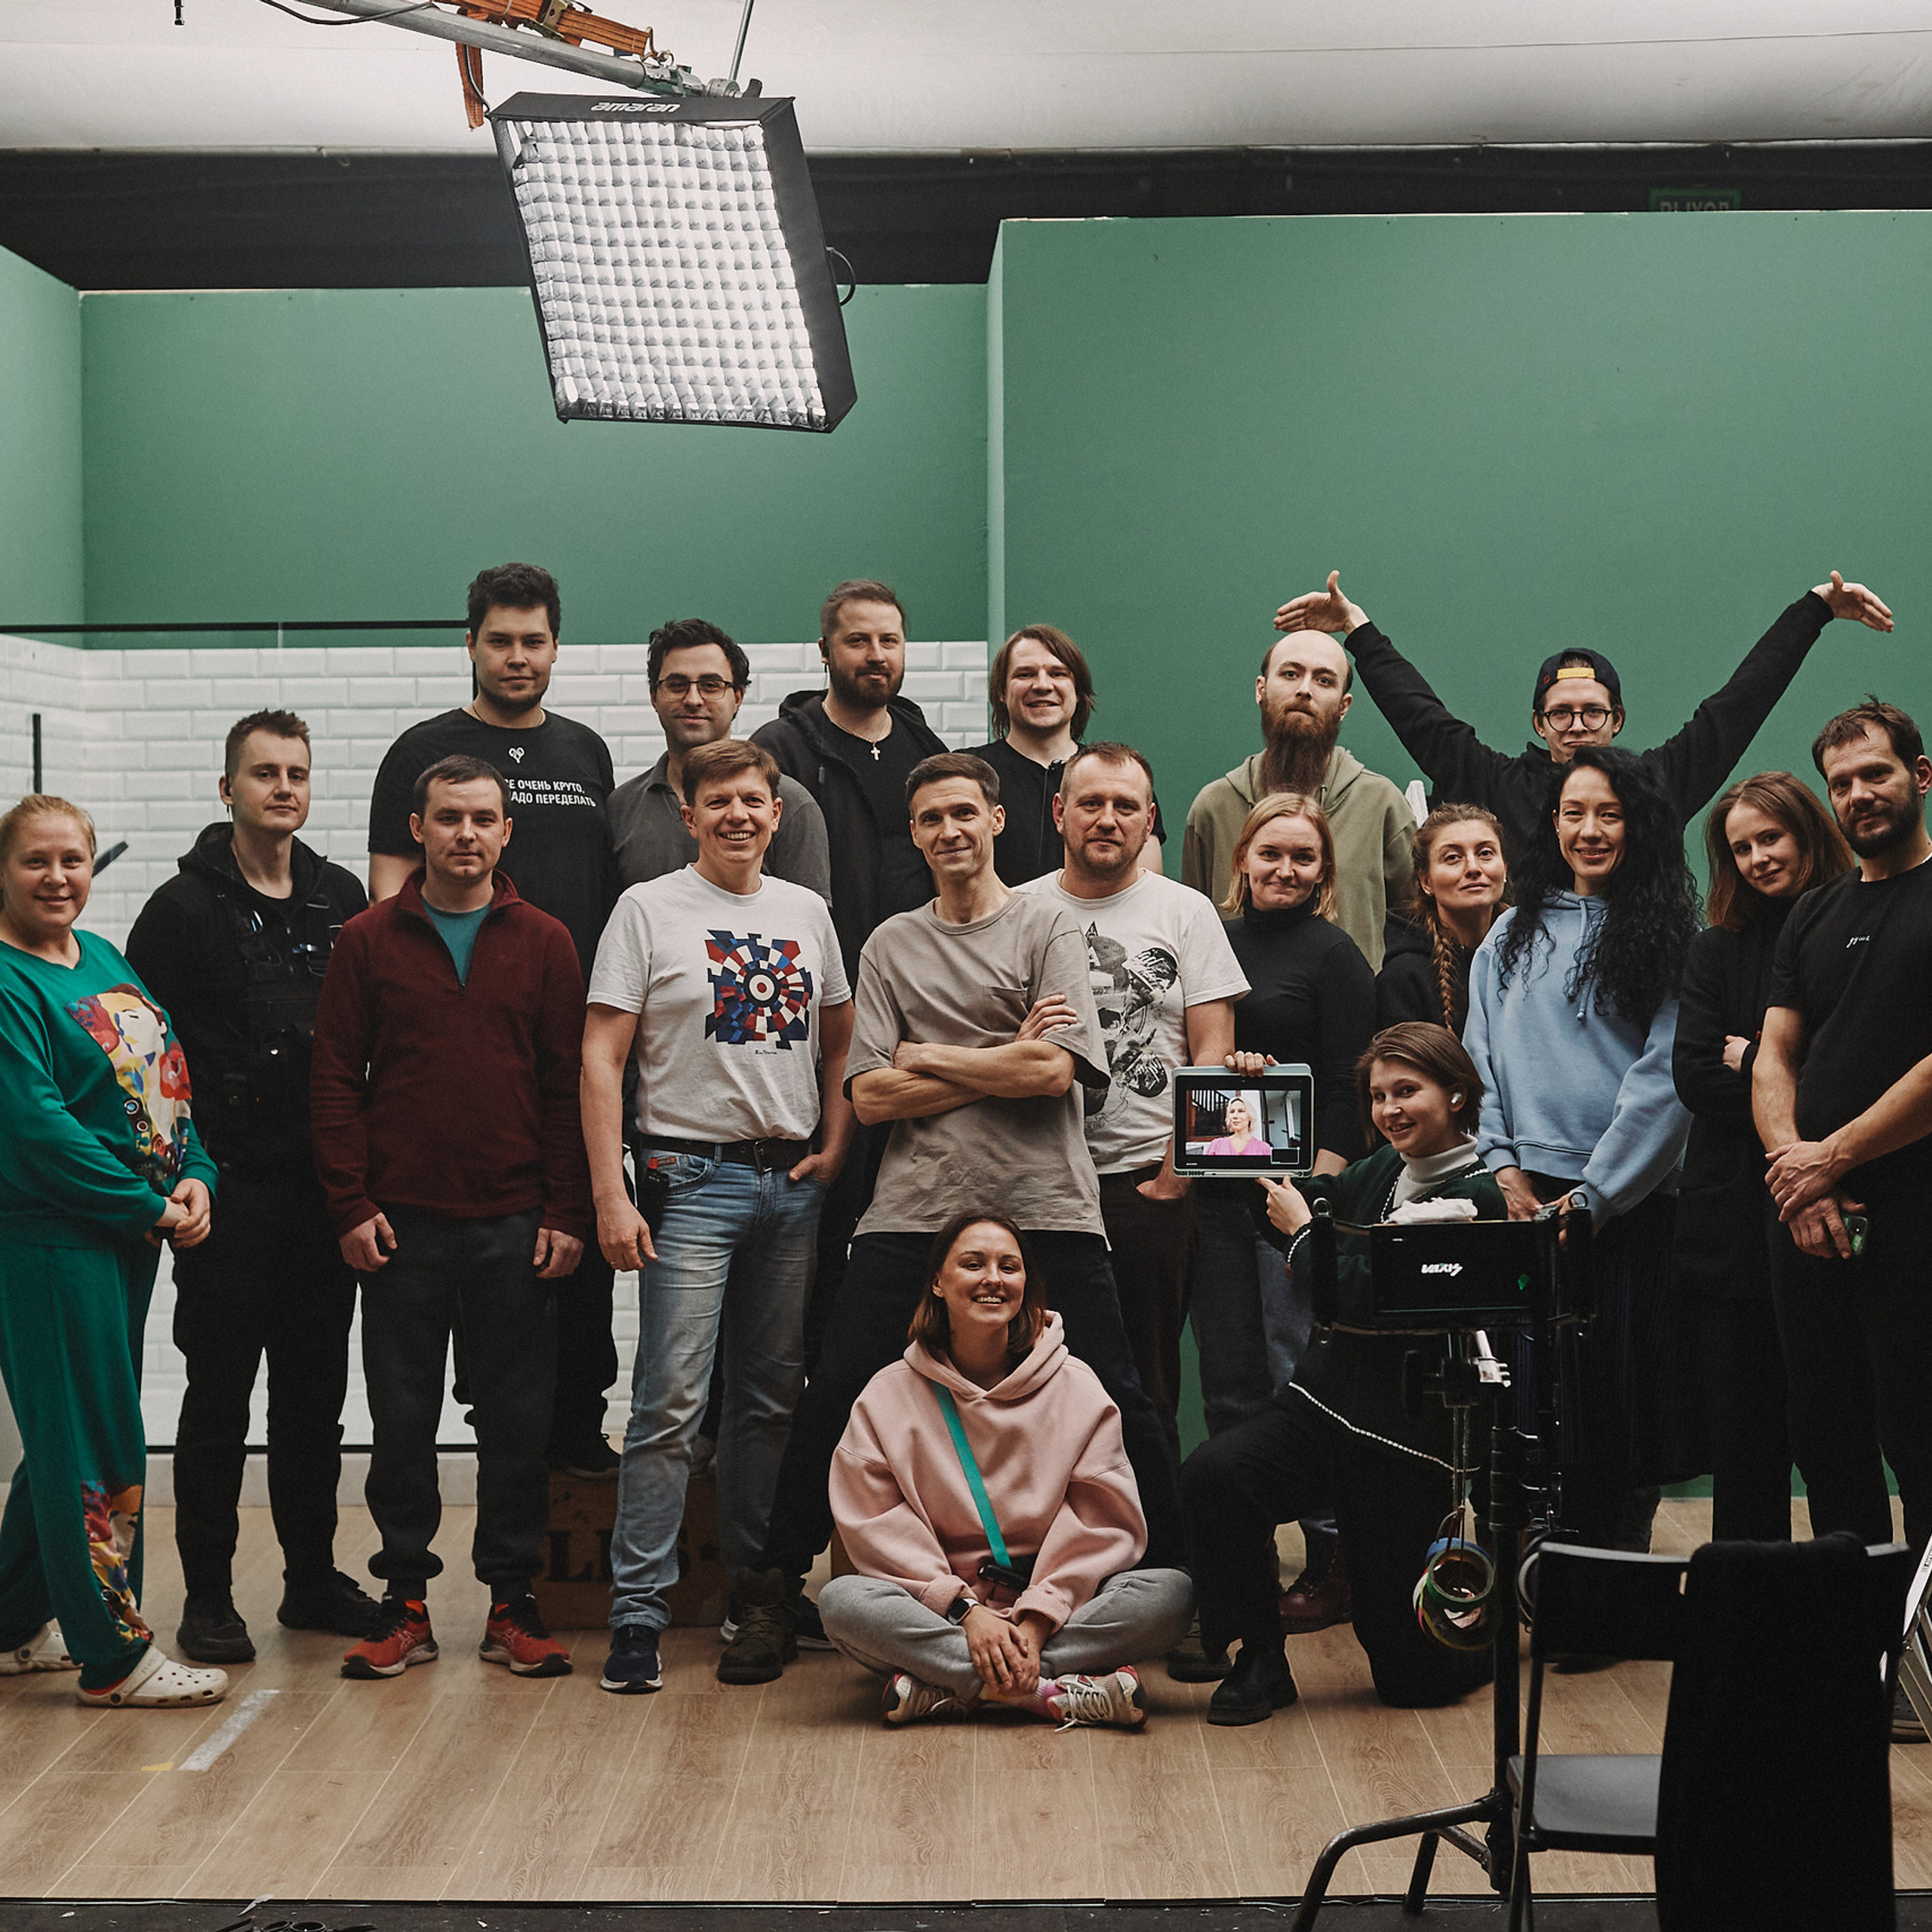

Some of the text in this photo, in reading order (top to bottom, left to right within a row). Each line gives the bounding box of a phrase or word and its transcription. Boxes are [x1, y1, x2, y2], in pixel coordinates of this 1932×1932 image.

[591, 101, 681, 112] amaran
[517, 779, 552, 791] ОЧЕНЬ
[552, 781, 586, 794] КРУТО.
[535, 793, 597, 808] ПЕРЕДЕЛАТЬ
